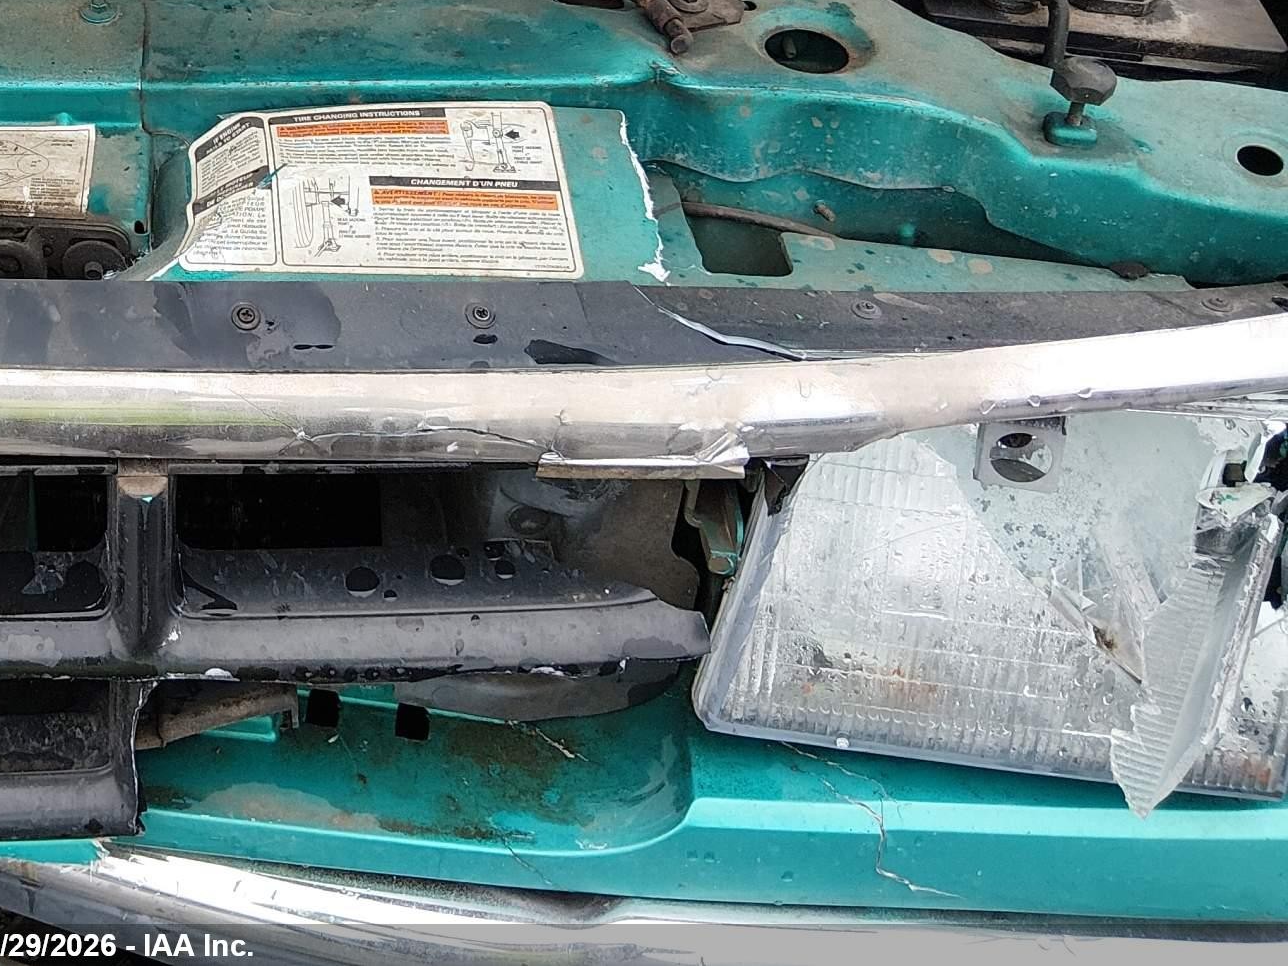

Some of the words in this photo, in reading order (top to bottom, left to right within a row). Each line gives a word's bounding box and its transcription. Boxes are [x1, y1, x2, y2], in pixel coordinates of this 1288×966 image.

[313, 112, 358, 121] CHANGING
[359, 110, 421, 119] INSTRUCTIONS
[410, 178, 472, 187] CHANGEMENT
